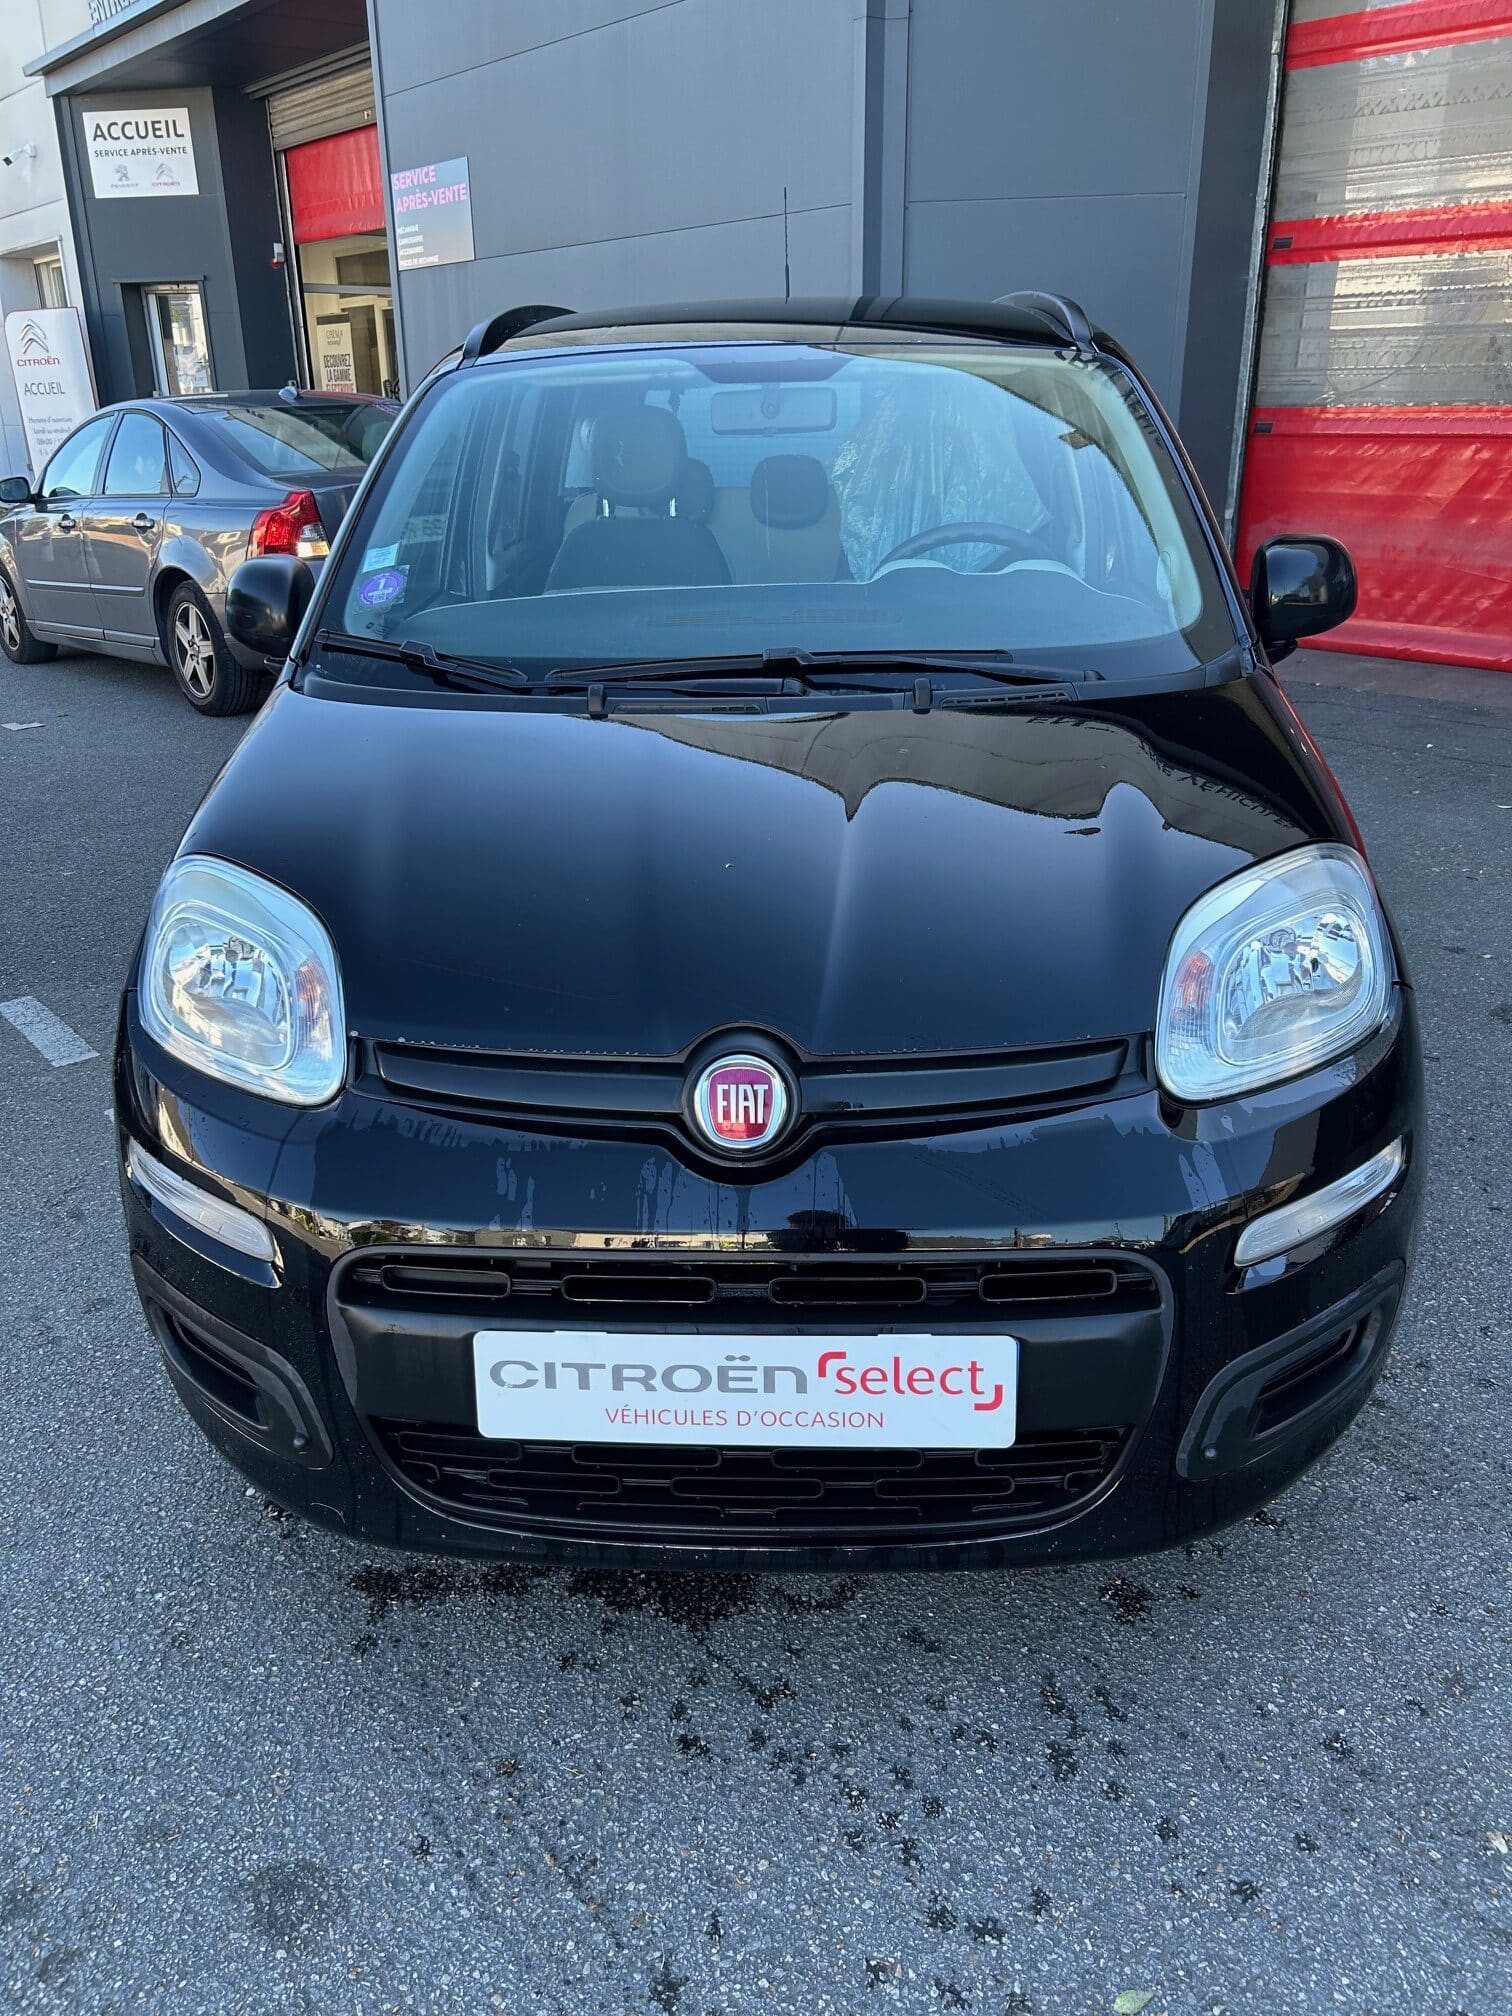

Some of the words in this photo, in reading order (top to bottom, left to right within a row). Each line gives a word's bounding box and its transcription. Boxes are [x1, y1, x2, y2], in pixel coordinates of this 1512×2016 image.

[92, 119, 185, 142] ACCUEIL
[94, 148, 129, 158] SERVICE
[130, 146, 188, 156] APRÈS-VENTE
[393, 165, 437, 190] SERVICE
[395, 183, 468, 214] APRÈS-VENTE
[17, 356, 60, 367] CITROËN
[24, 382, 66, 396] ACCUEIL
[716, 1084, 769, 1124] FIAT
[488, 1353, 809, 1396] CITROËN
[833, 1355, 987, 1396] select
[604, 1403, 730, 1427] VÉHICULES
[736, 1408, 885, 1429] D'OCCASION
